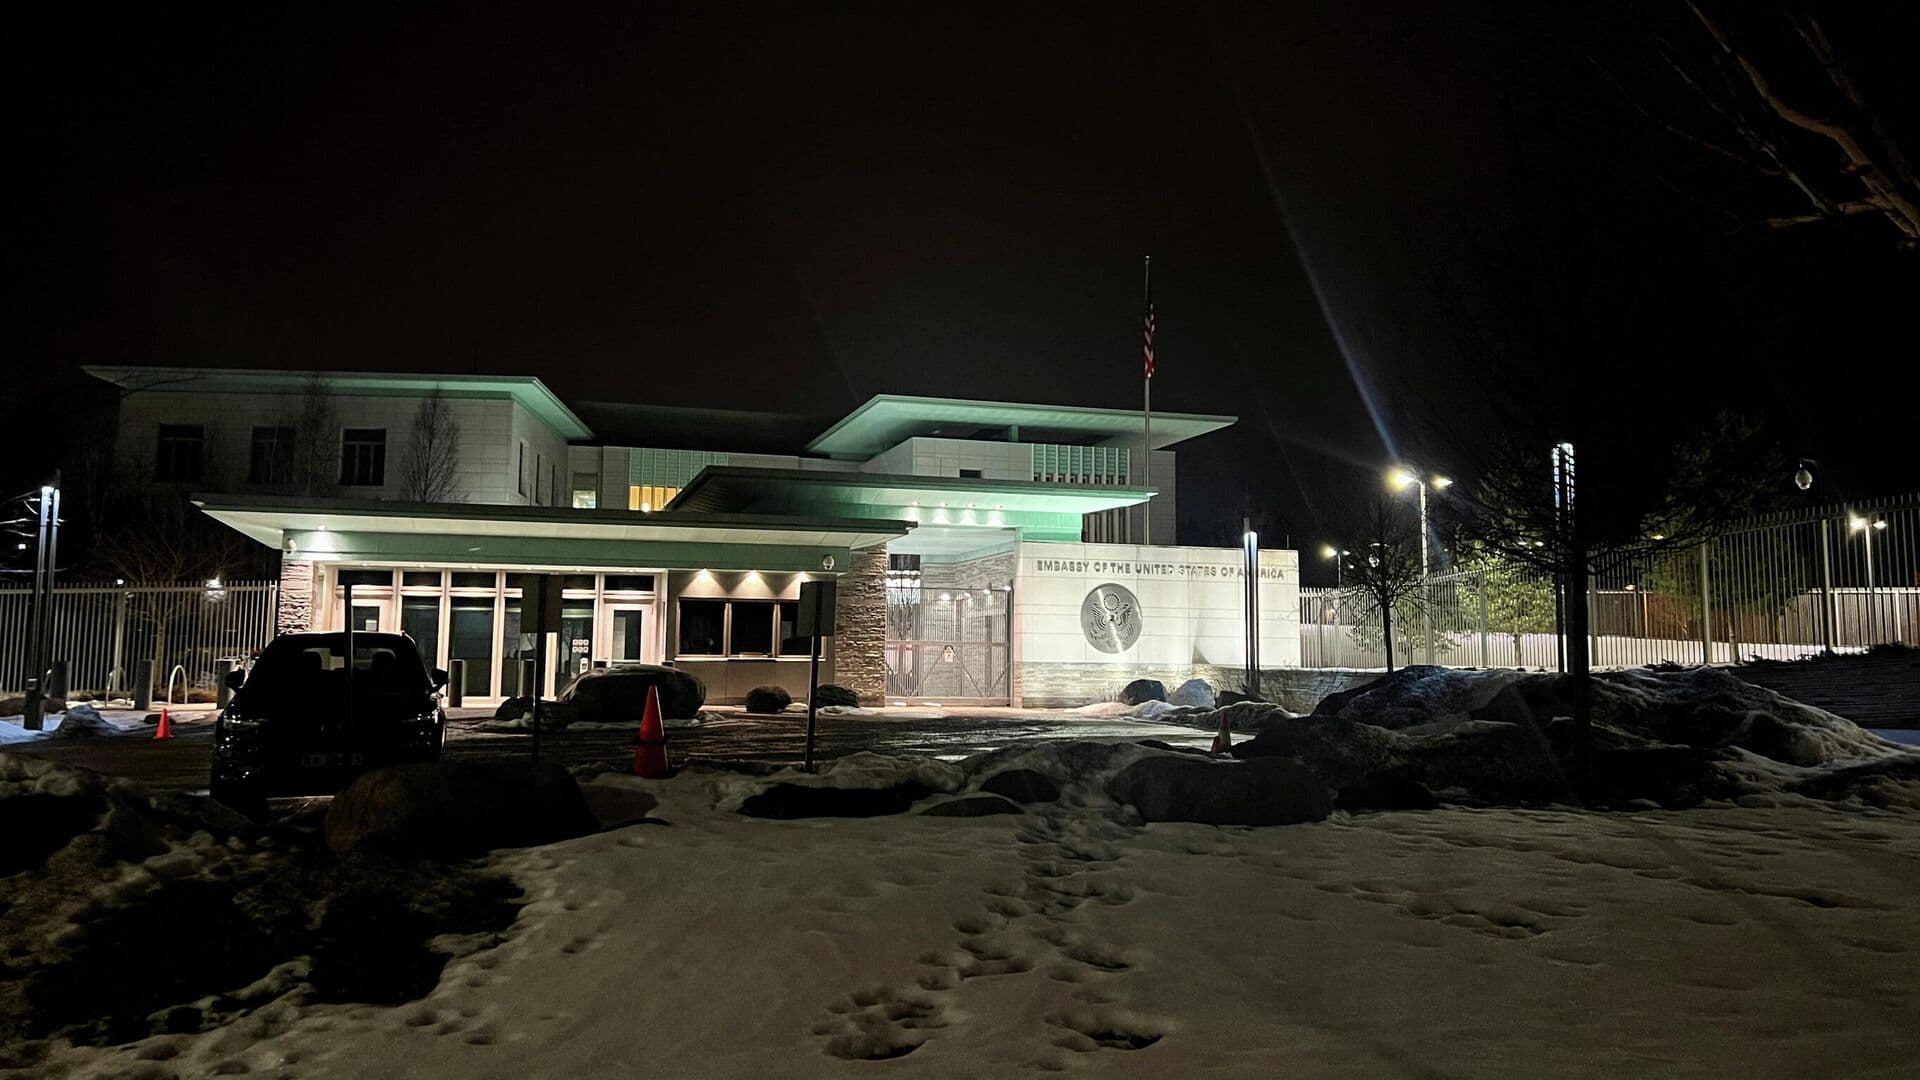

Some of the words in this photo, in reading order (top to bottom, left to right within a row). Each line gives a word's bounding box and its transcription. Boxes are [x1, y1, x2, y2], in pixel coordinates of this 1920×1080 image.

[1037, 560, 1089, 572] EMBASSY
[1094, 562, 1108, 573] OF
[1110, 562, 1131, 574] THE
[1135, 563, 1174, 575] UNITED
[1178, 565, 1217, 577] STATES
[1220, 567, 1234, 577] OF
[1237, 567, 1284, 579] ARICA
